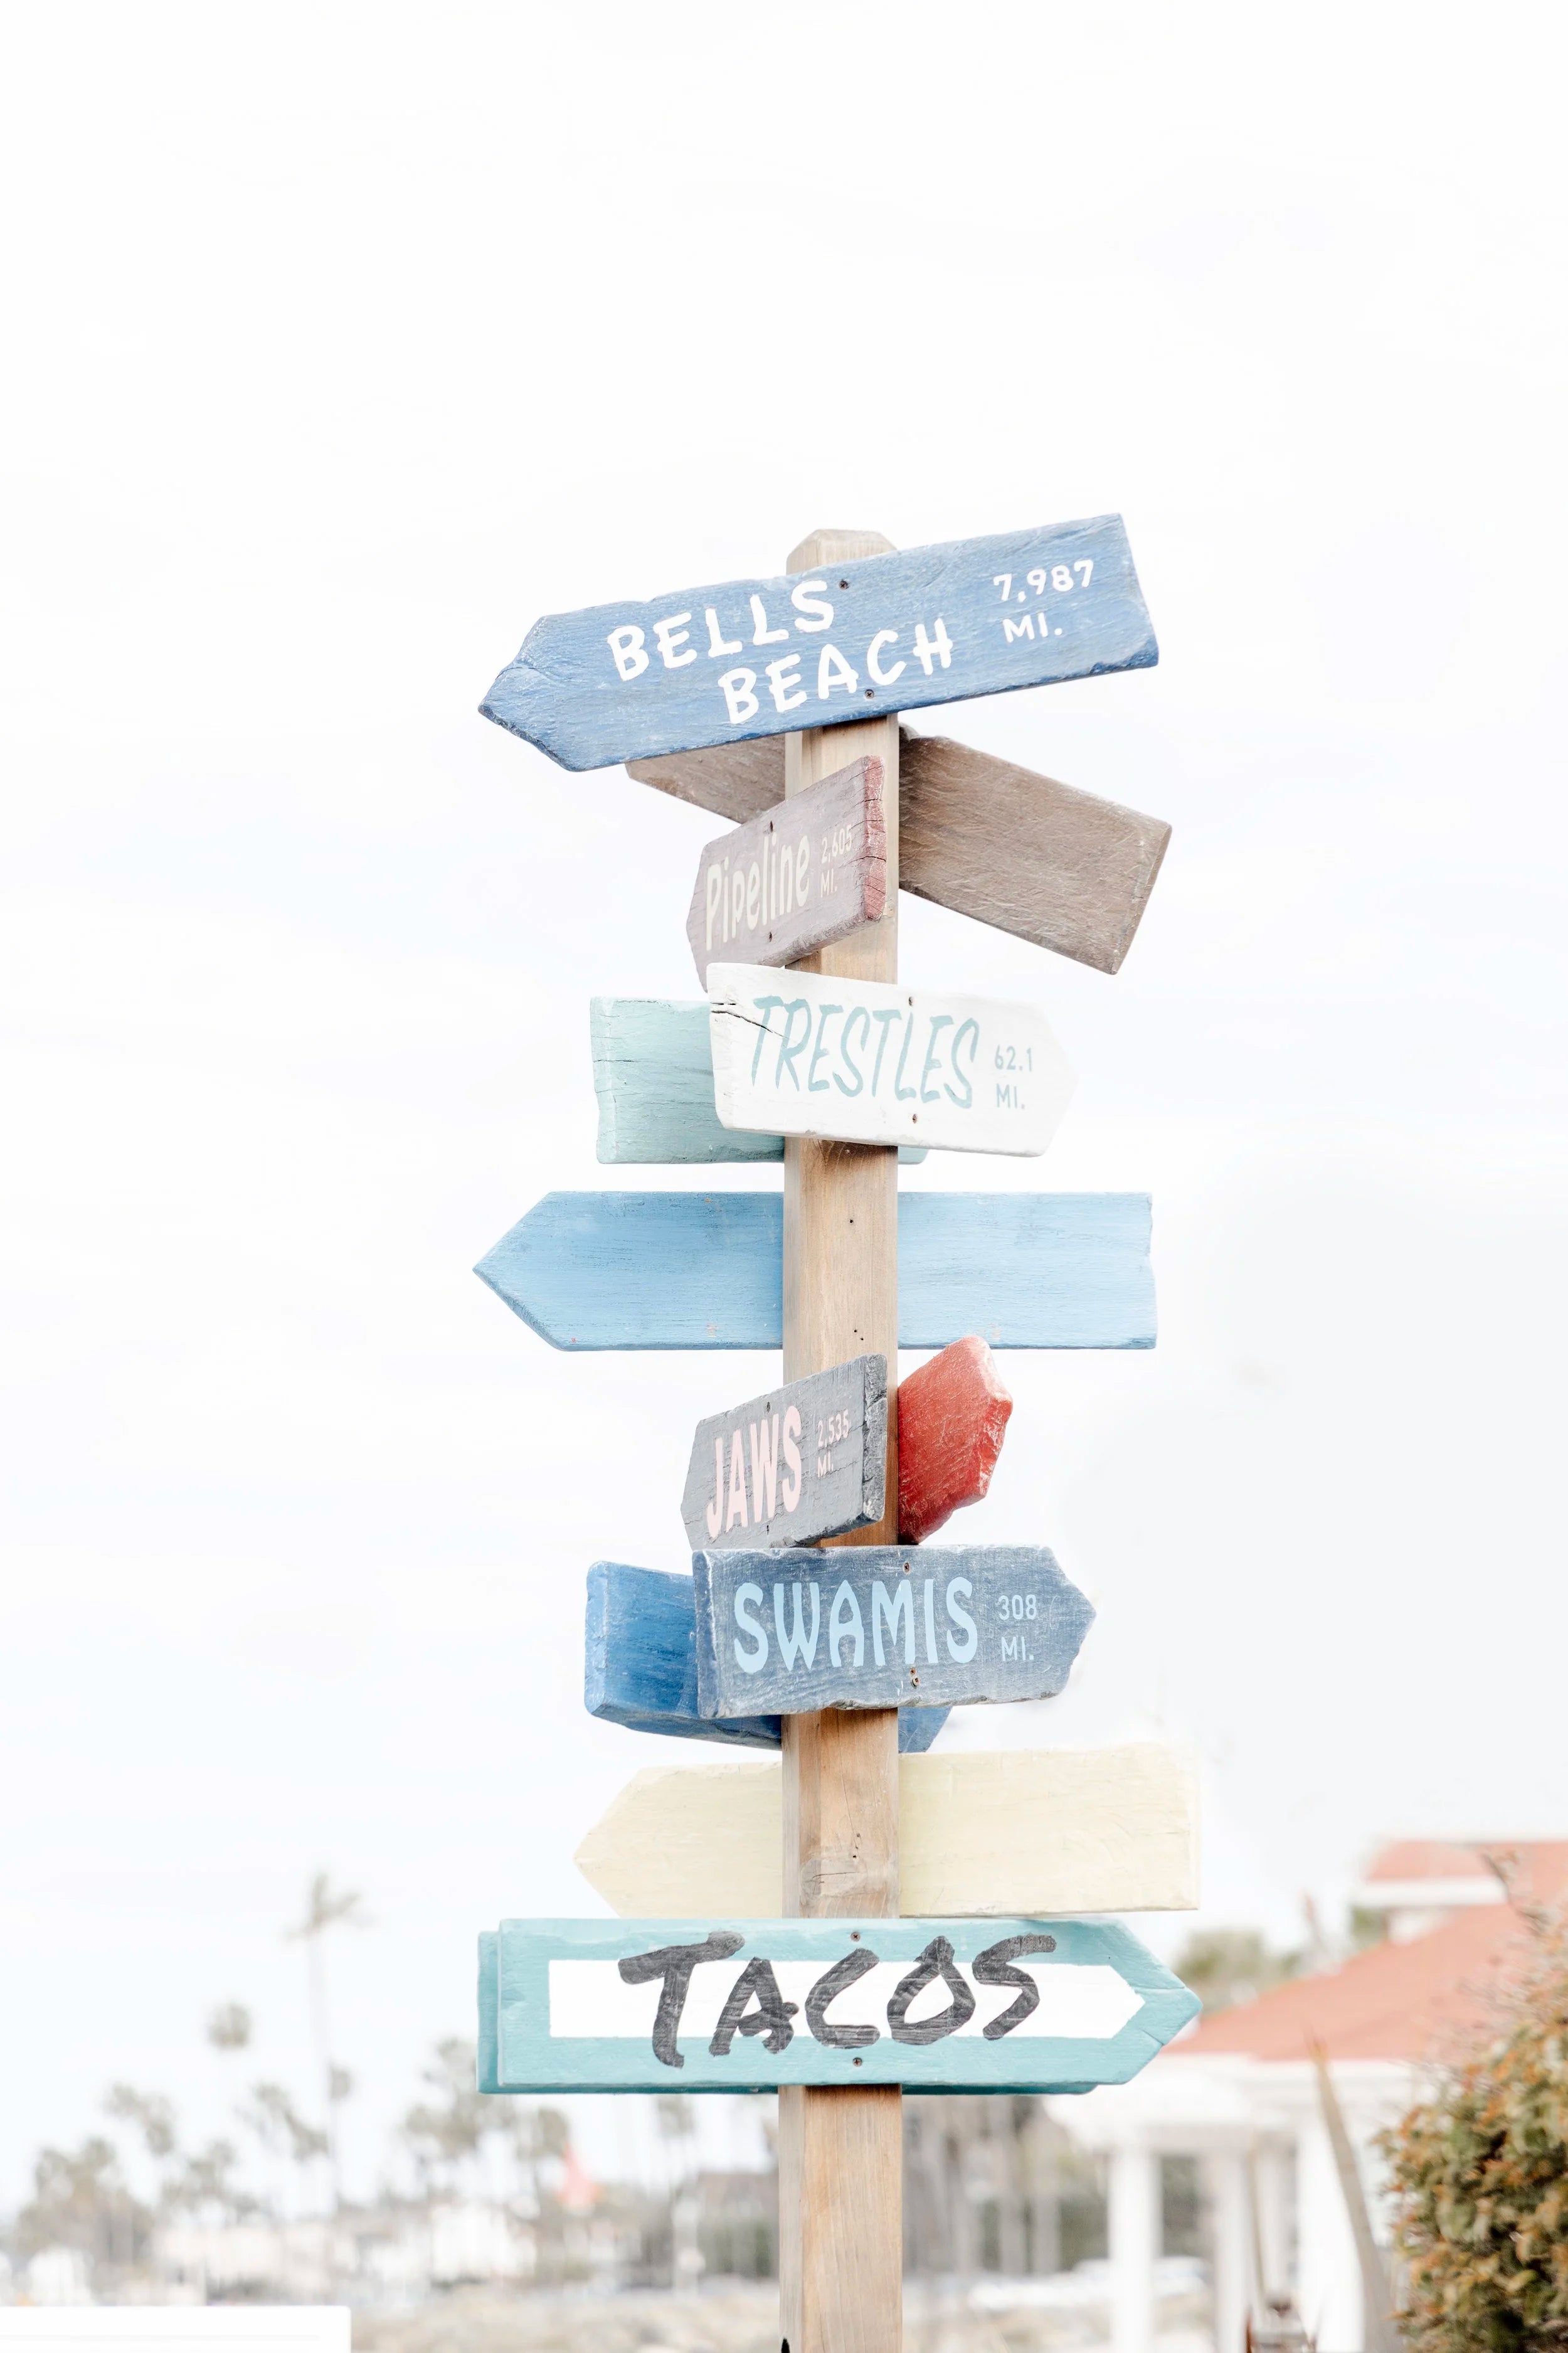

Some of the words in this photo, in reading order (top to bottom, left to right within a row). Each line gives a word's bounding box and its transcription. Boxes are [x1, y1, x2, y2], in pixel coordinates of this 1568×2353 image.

[992, 559, 1095, 602] 7,987
[607, 580, 835, 682] BELLS
[1003, 611, 1063, 644] MI.
[718, 617, 953, 725] BEACH
[821, 824, 852, 864] 2,605
[706, 832, 810, 952] Pipeline
[820, 868, 838, 898] MI.
[751, 995, 980, 1109] TRESTLES
[994, 1044, 1033, 1072] 62.1
[995, 1083, 1025, 1110] MI.
[817, 1409, 849, 1447] 2,535
[706, 1405, 802, 1538] JAWS
[817, 1450, 834, 1479] MI.
[734, 1576, 978, 1674] SWAMIS
[997, 1593, 1037, 1620] 308
[1001, 1637, 1035, 1662] MI.
[617, 1931, 1057, 2069] TACOS
